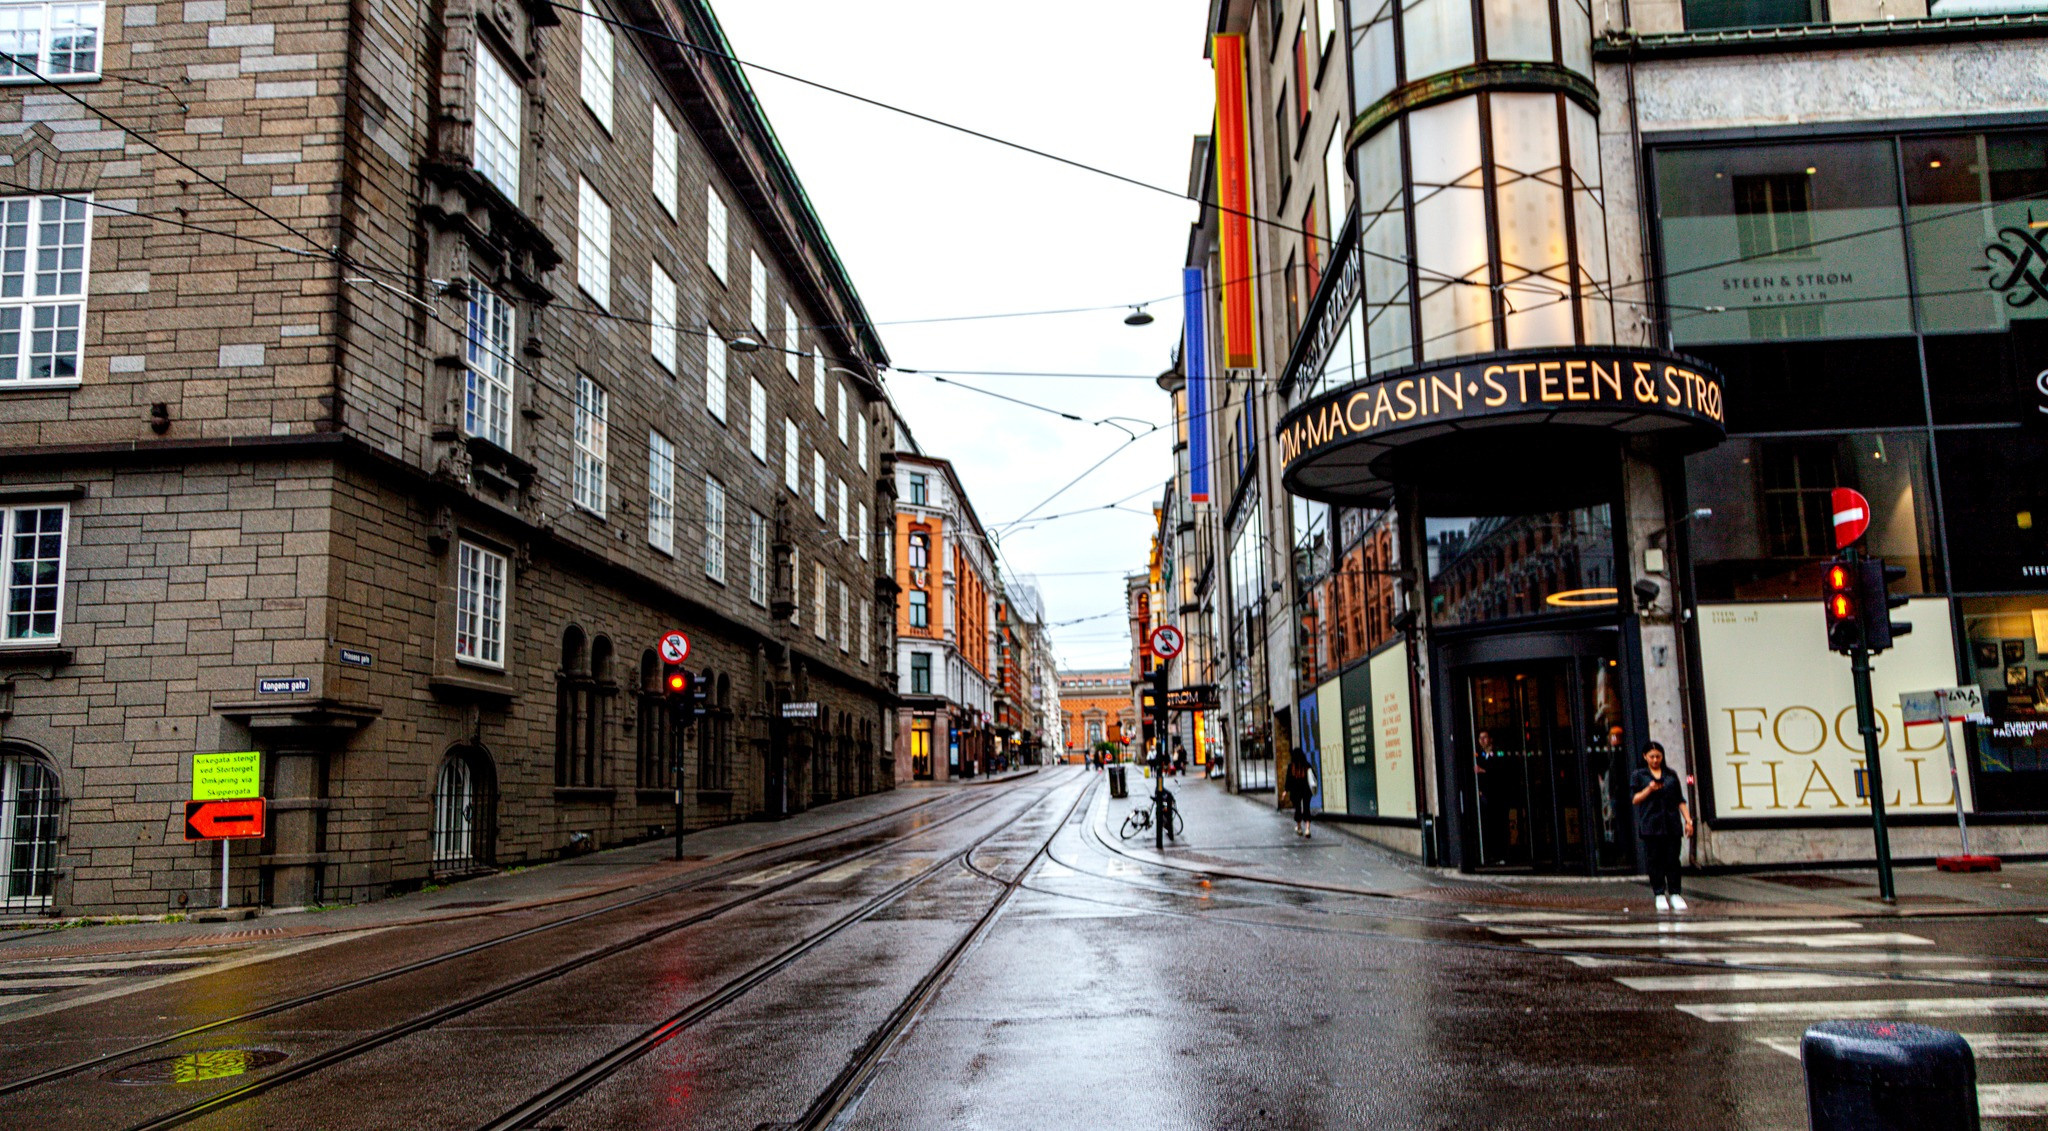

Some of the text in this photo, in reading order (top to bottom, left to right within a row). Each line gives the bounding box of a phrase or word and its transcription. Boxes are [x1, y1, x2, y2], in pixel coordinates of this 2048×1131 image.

[1722, 272, 1853, 290] STEEN & STRØM
[1306, 371, 1463, 449] MAGASIN
[1483, 360, 1623, 407] STEEN
[1632, 361, 1659, 404] &
[263, 680, 306, 692] Kongens gate
[1721, 704, 1947, 756] FOOD
[233, 755, 257, 764] stengt
[216, 765, 254, 773] Stortorget
[201, 777, 238, 785] Omkjøring
[207, 787, 251, 796] Skippergata
